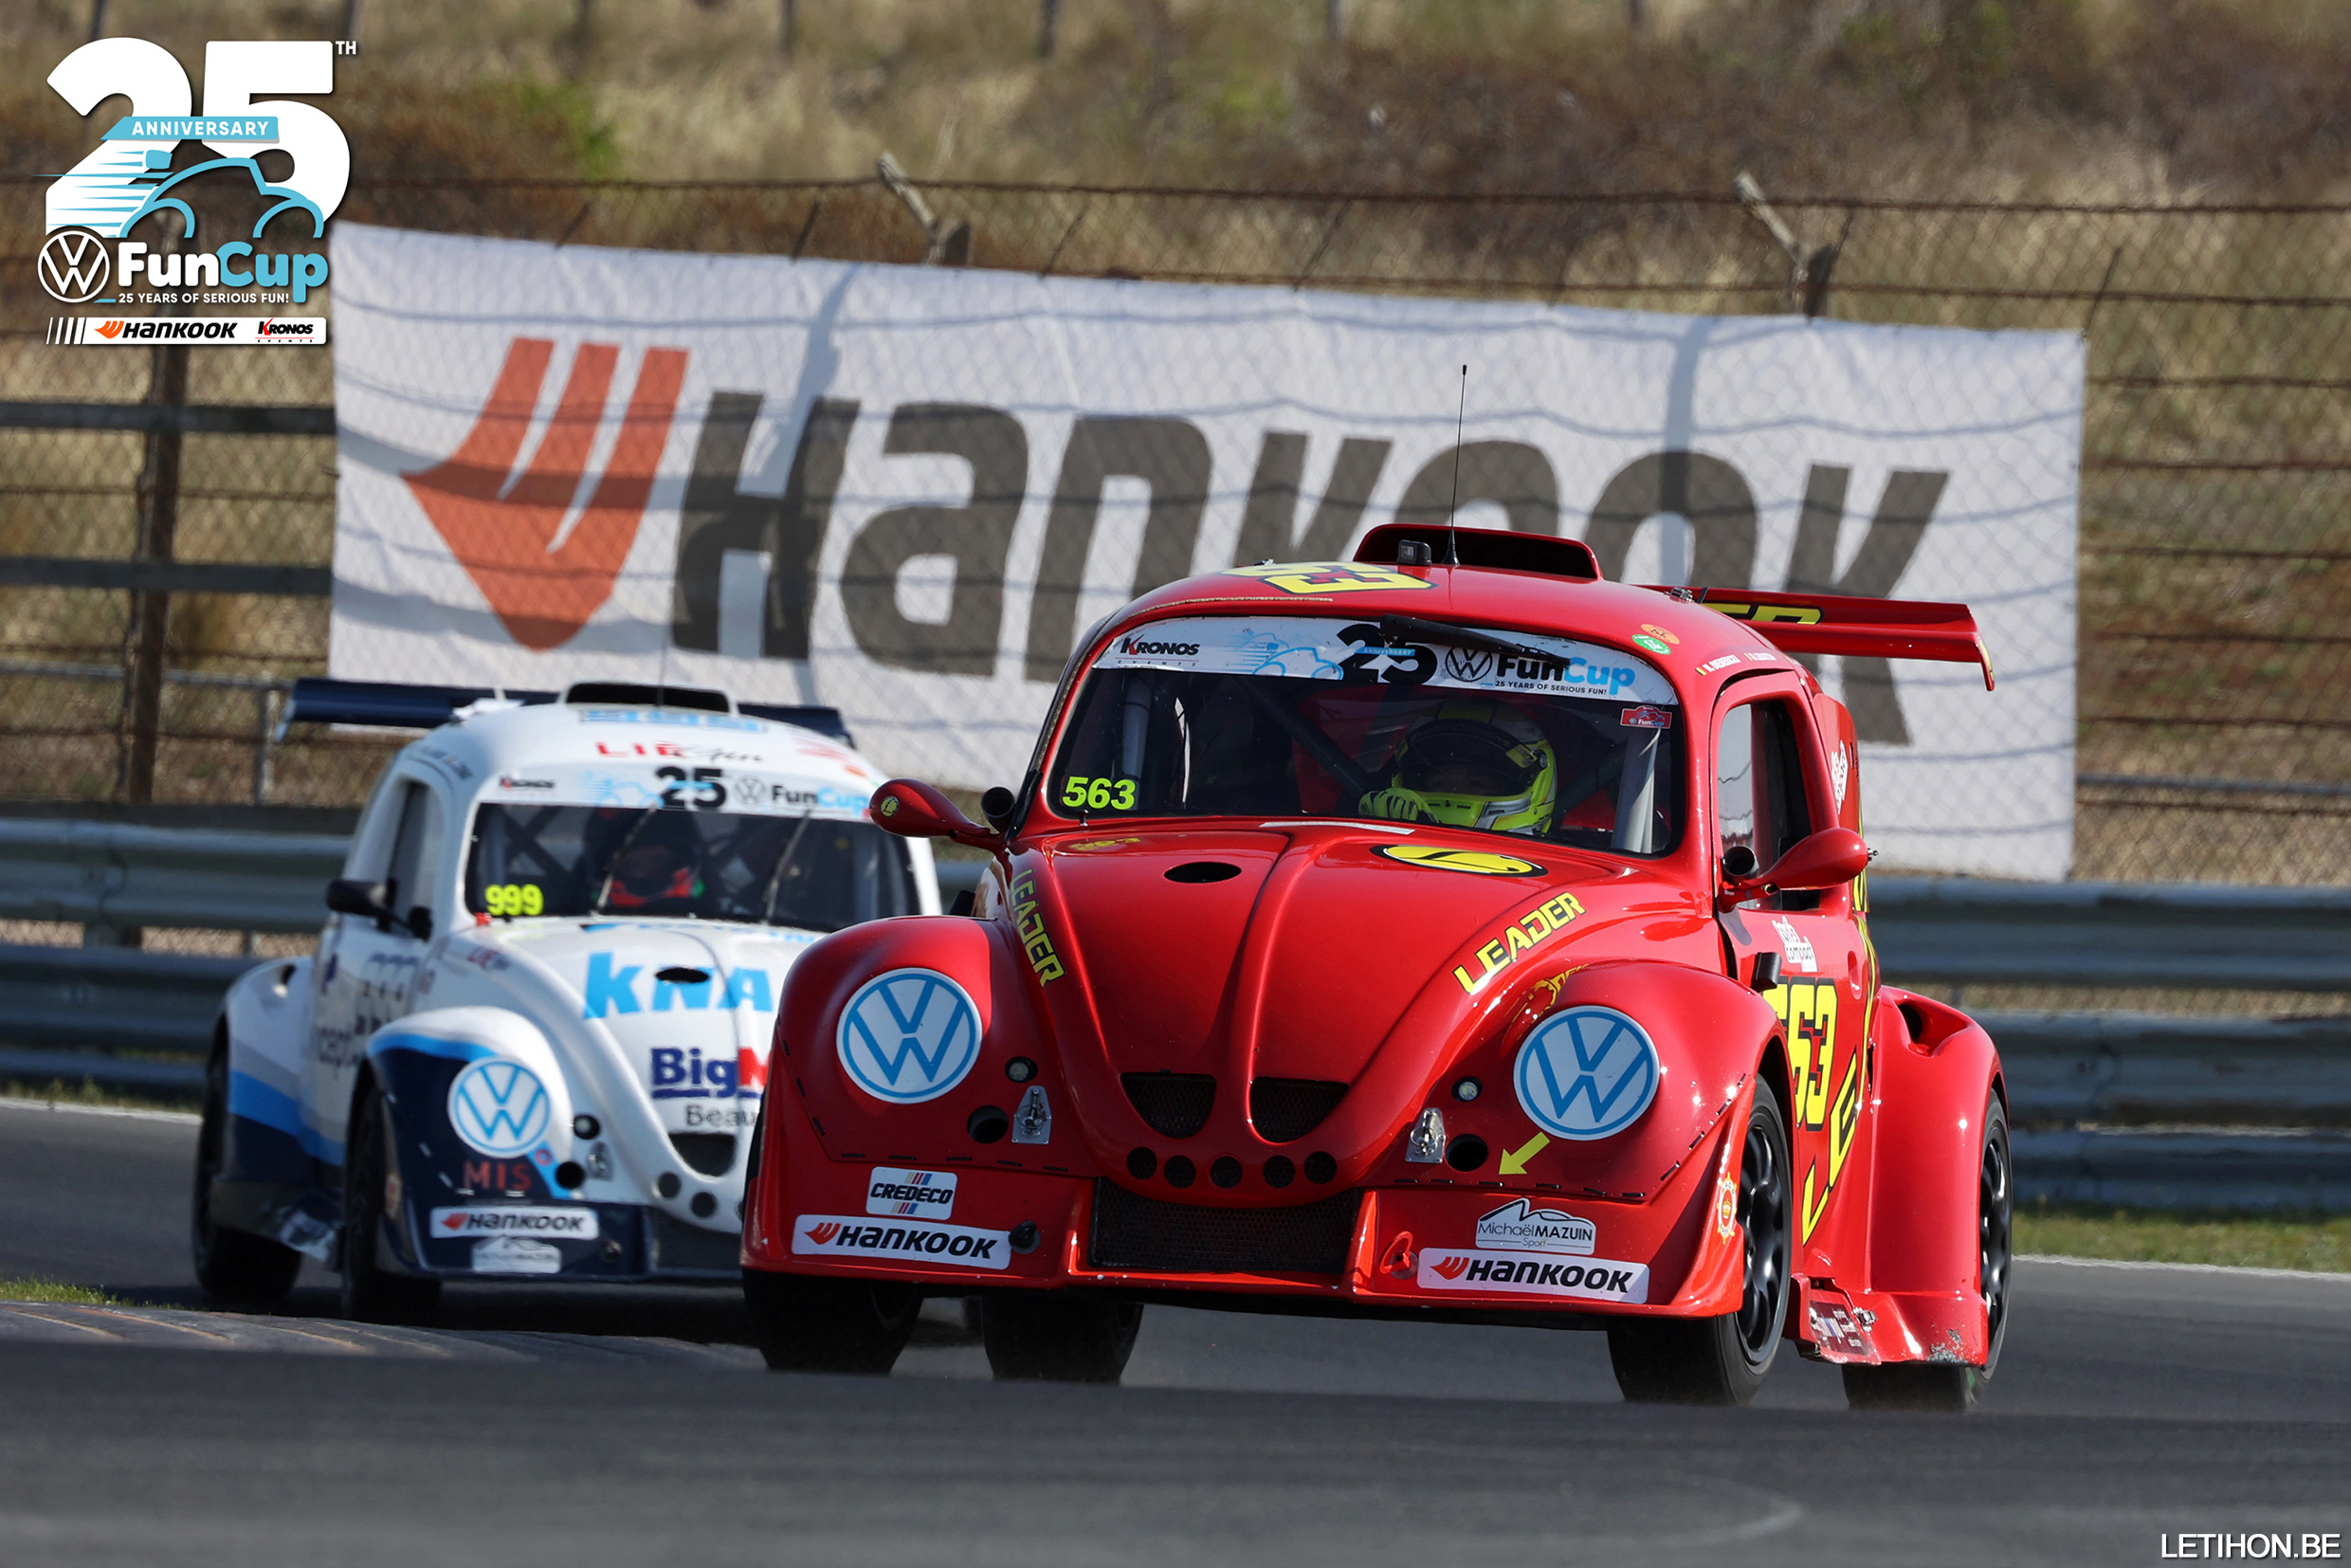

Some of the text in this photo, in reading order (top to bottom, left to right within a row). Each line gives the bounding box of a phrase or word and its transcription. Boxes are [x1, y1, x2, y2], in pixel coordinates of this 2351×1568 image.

[1120, 633, 1200, 656] KRONOS
[1507, 682, 1535, 690] YEARS
[1062, 776, 1136, 811] 563
[484, 884, 544, 916] 999
[1010, 868, 1066, 988] LEADER
[1452, 891, 1586, 995] LEADER
[464, 1159, 532, 1191] MIS
[869, 1182, 954, 1204] CREDECO
[1522, 1236, 1547, 1249] Sport
